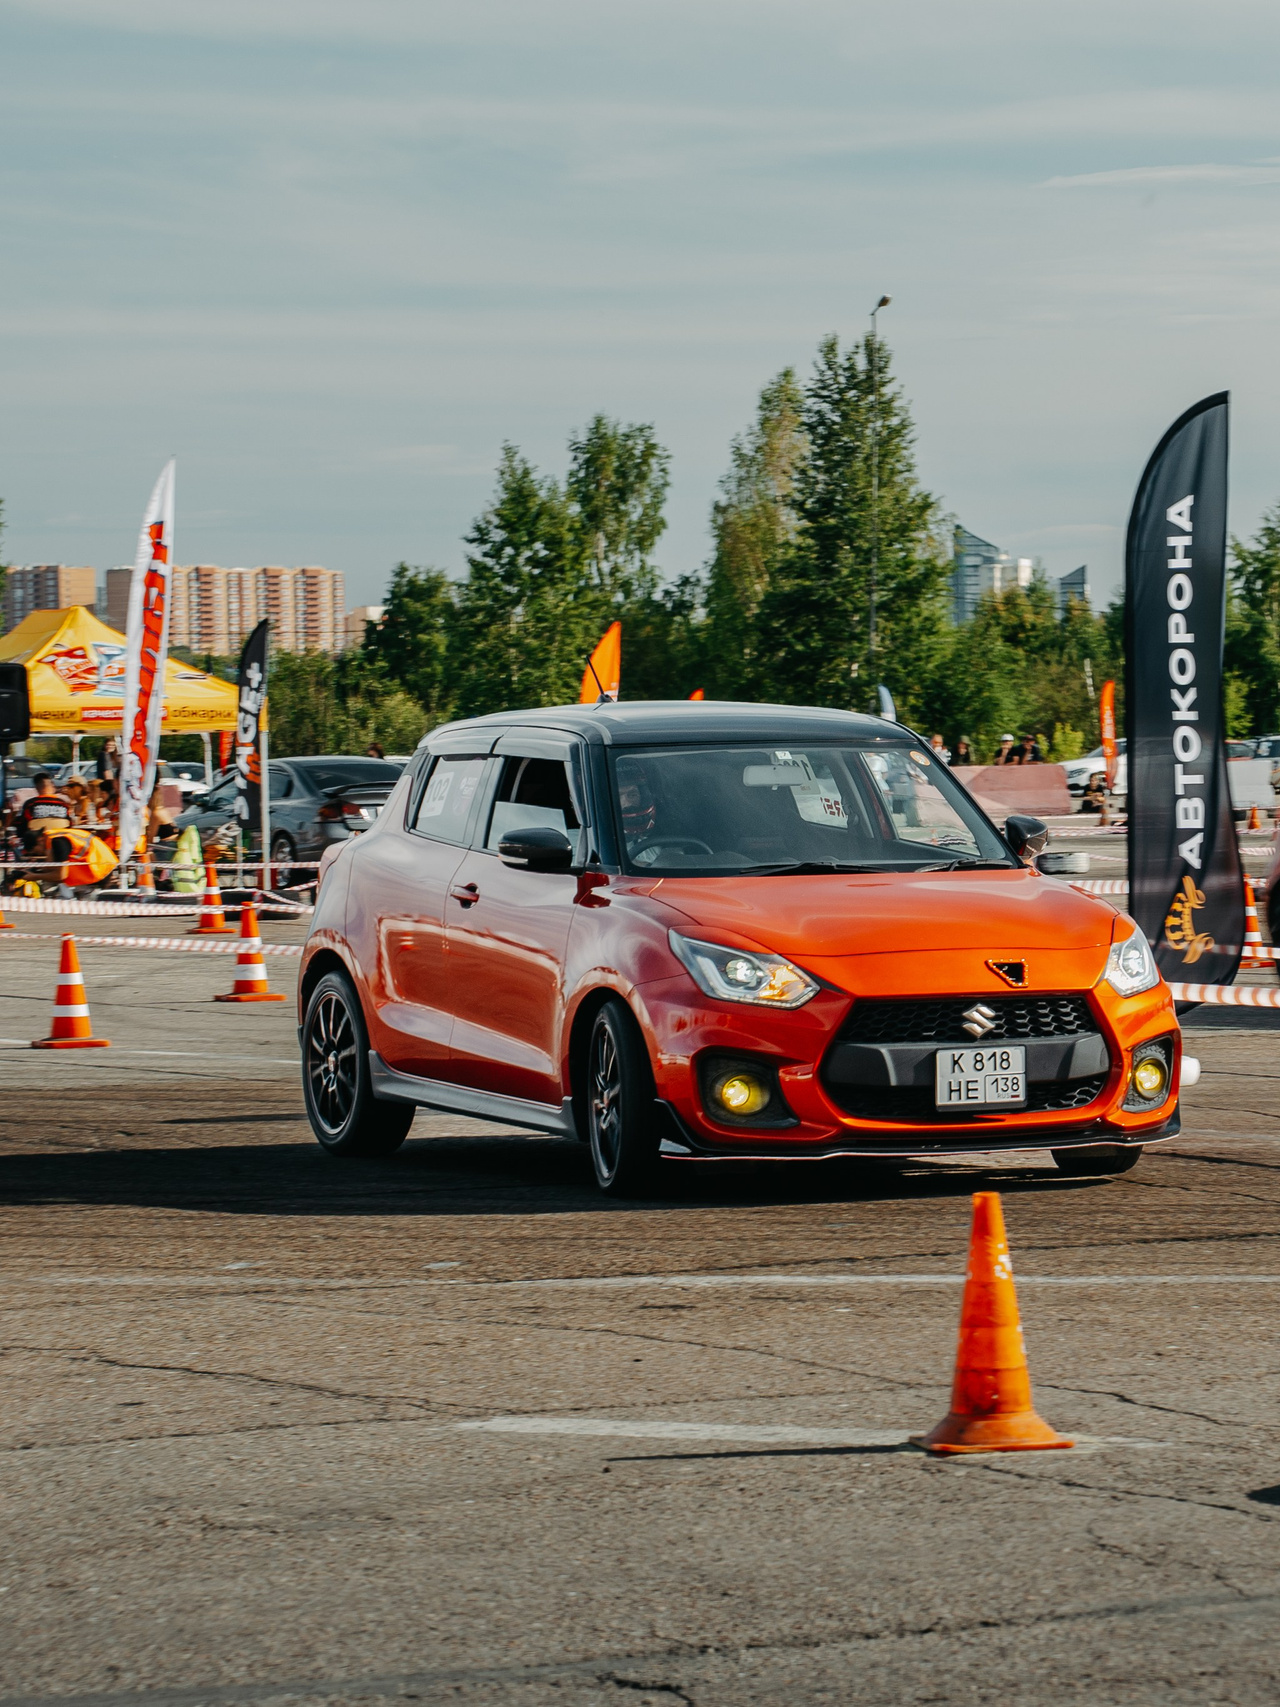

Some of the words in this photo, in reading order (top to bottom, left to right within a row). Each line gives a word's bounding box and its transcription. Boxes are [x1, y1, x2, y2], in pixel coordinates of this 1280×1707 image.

[1166, 494, 1205, 870] АВТОКОРОНА
[973, 1051, 1011, 1072] 818
[991, 1076, 1020, 1093] 138
